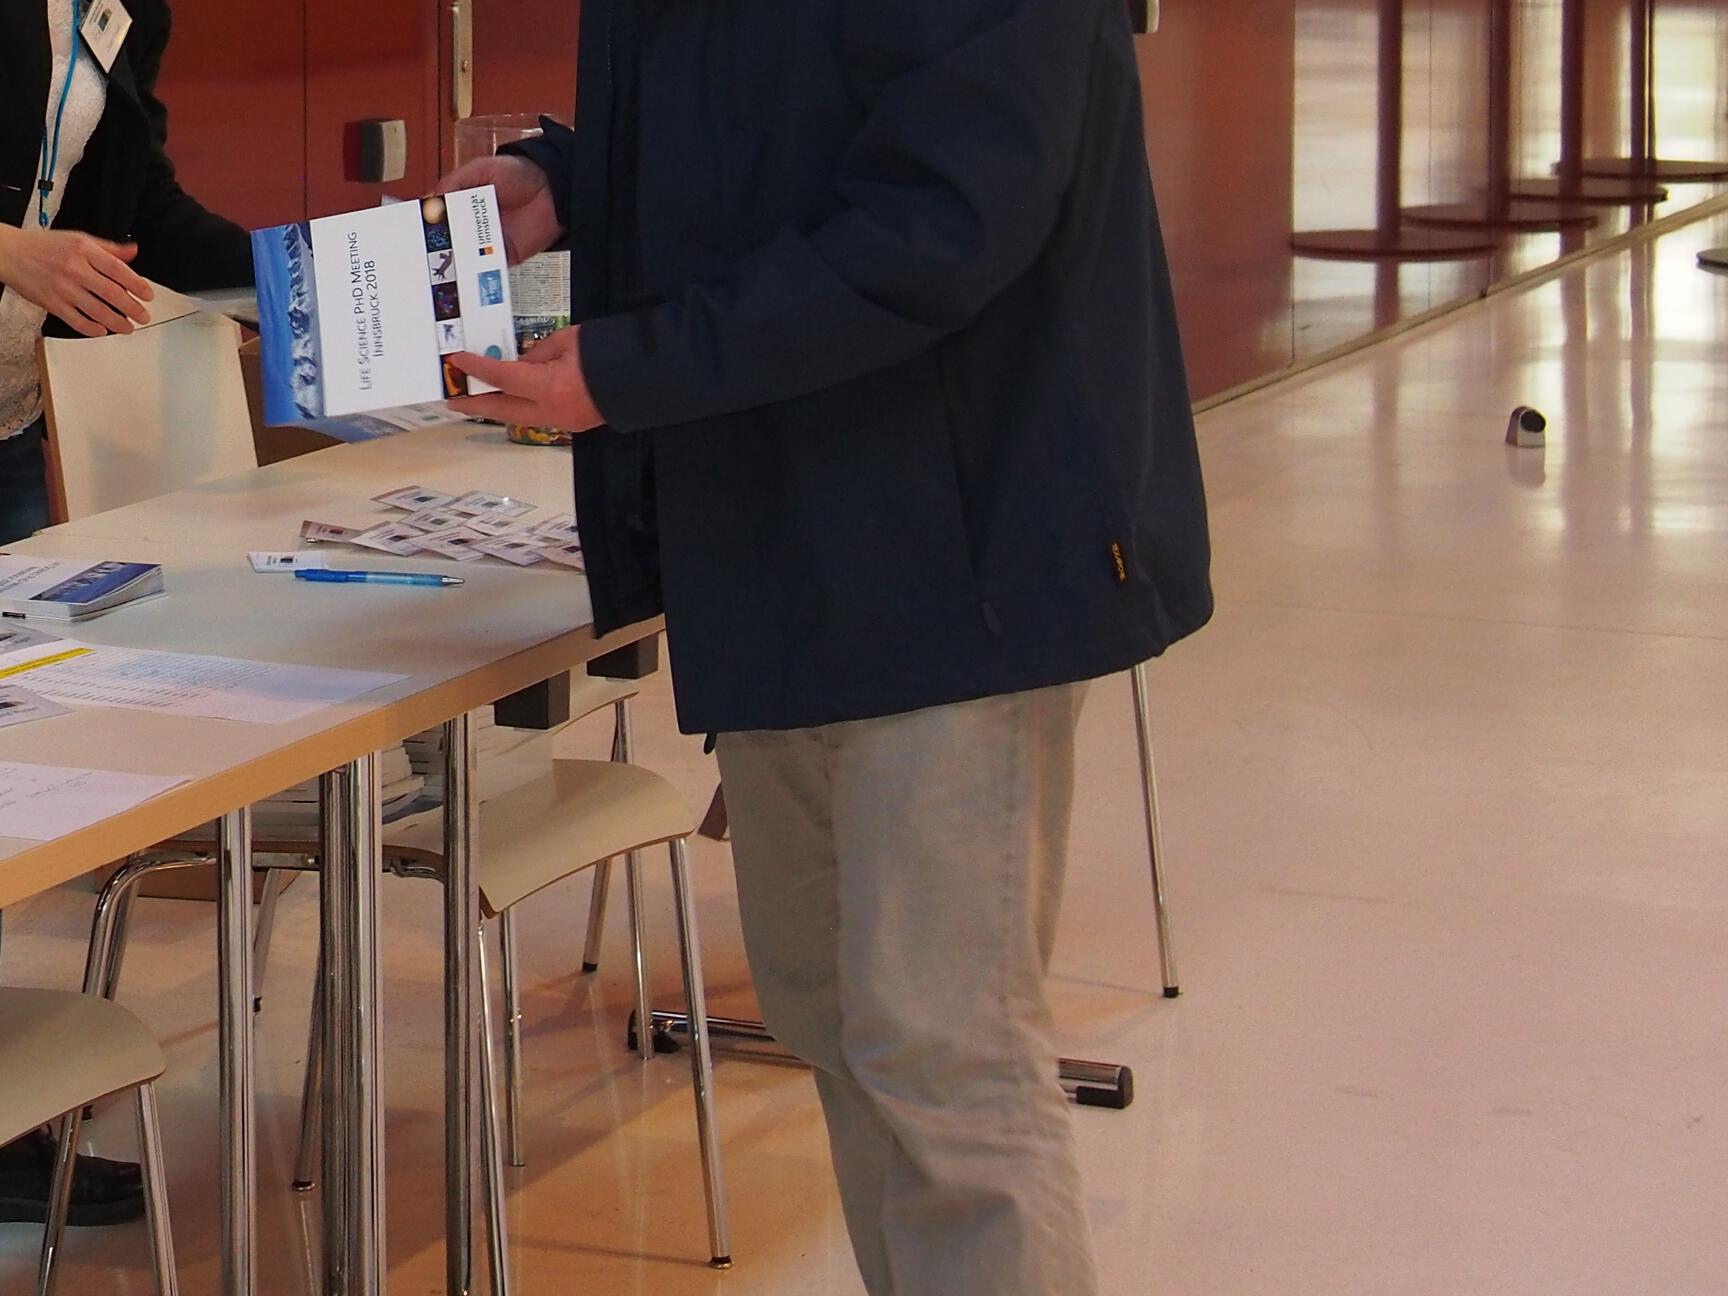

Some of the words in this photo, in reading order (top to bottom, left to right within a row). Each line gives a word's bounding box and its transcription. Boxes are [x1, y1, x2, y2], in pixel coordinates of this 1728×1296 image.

[478, 197, 493, 244] innsbruck
[347, 231, 362, 284] MEETING
[364, 260, 379, 290] 2018
[354, 318, 370, 365] SCIENCE
[368, 293, 384, 357] INNSBRUCK
[359, 369, 373, 391] LIFE
